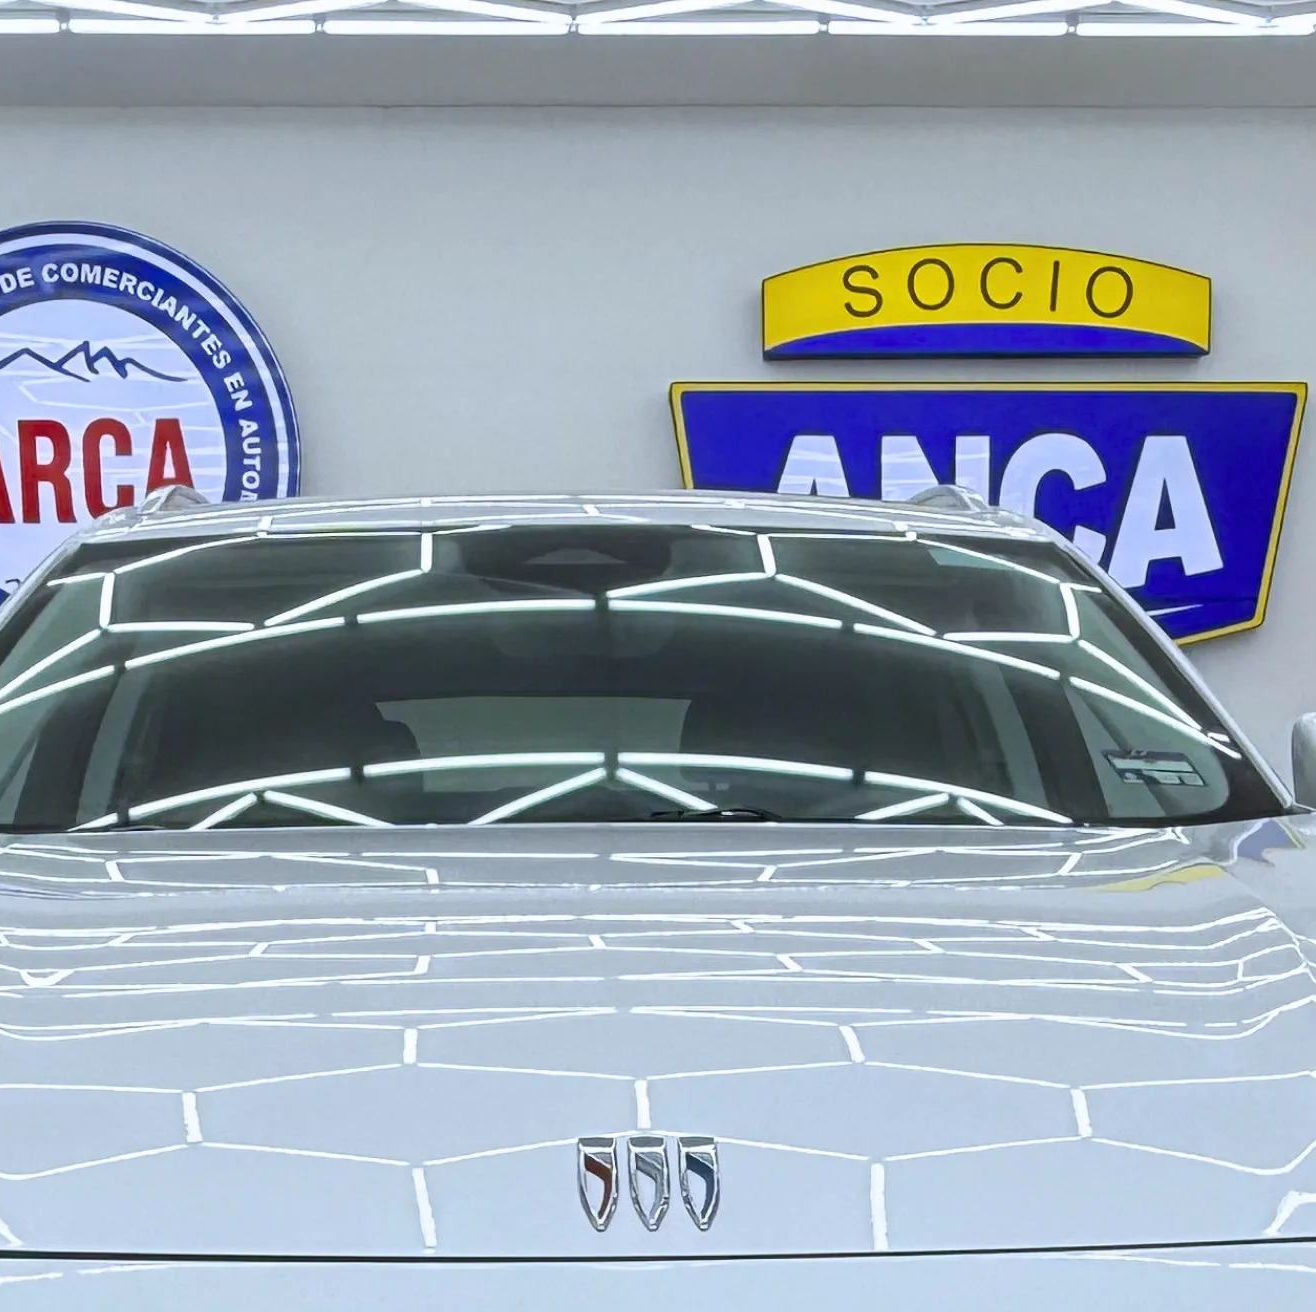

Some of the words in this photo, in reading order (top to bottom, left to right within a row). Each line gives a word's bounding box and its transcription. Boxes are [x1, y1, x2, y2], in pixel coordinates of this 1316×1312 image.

[41, 262, 231, 370] COMERCIANTES
[223, 371, 253, 412] EN
[843, 257, 1134, 319] SOCIO
